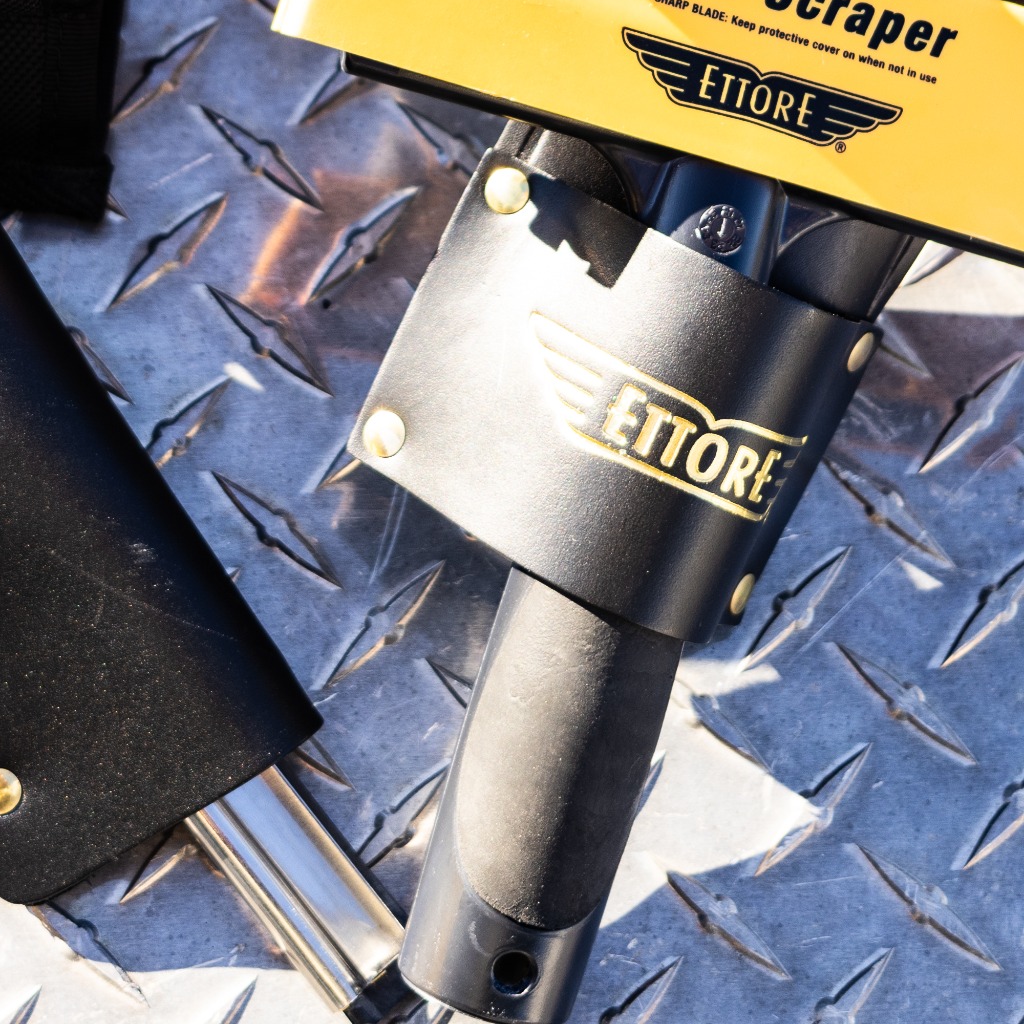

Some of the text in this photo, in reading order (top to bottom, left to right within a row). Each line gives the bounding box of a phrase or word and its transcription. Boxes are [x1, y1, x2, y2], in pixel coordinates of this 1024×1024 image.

[691, 3, 729, 23] BLADE:
[730, 14, 756, 32] Keep
[757, 25, 810, 47] protective
[812, 40, 841, 56] cover
[842, 49, 856, 60] on
[858, 53, 886, 69] when
[887, 63, 905, 75] not
[907, 67, 917, 78] in
[919, 73, 938, 84] use
[699, 63, 817, 128] ETTORE
[602, 382, 782, 503] ETTORE
